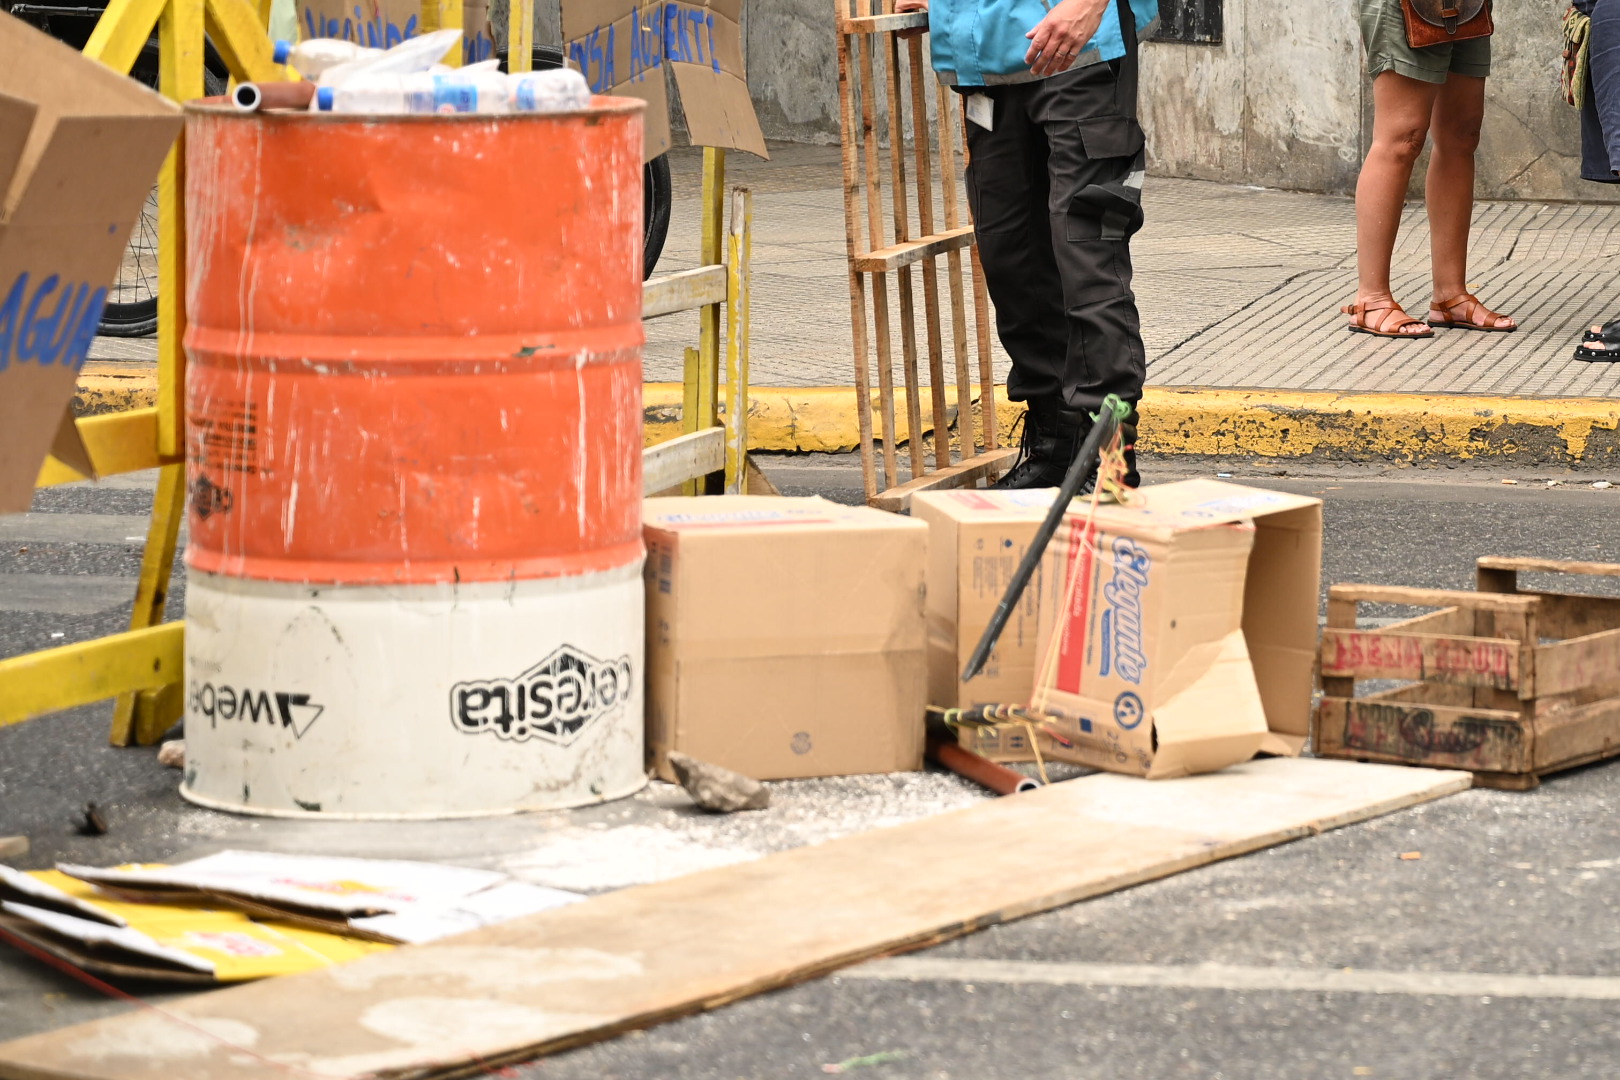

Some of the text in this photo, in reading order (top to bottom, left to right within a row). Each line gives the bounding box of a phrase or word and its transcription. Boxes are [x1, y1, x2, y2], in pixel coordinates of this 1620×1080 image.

[0, 271, 108, 373] AGUA
[1104, 534, 1152, 686] Elegante
[458, 660, 633, 736] ceresita
